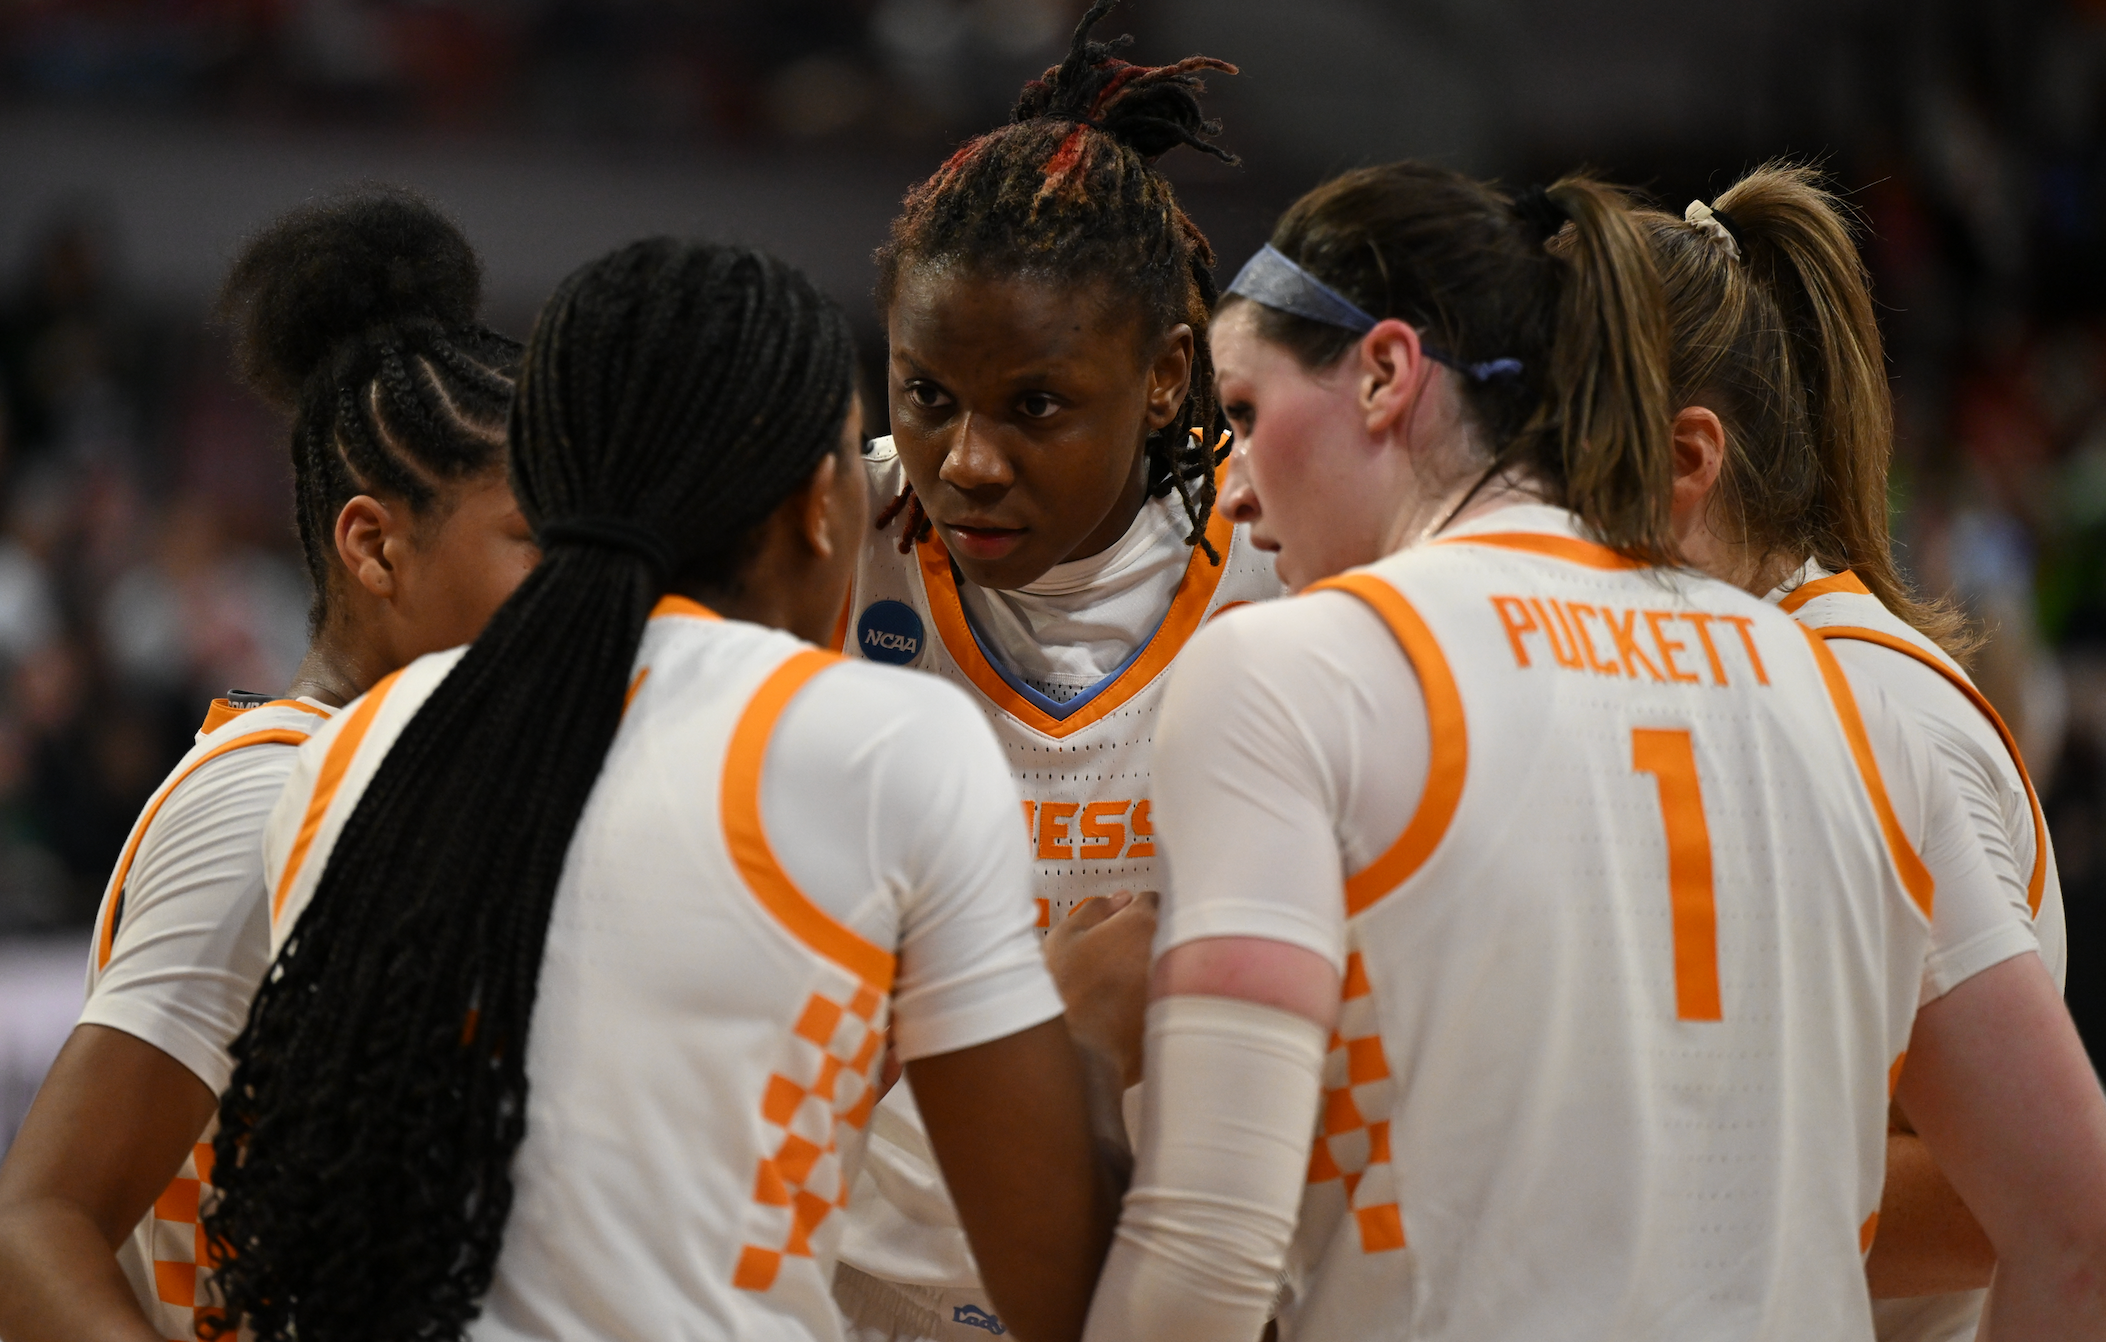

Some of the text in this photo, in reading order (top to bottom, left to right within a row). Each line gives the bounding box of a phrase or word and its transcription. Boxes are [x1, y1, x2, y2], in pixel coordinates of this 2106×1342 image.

[864, 628, 918, 654] NCAA
[1490, 595, 1771, 686] PUCKETT
[1021, 798, 1156, 860] ESS
[1632, 728, 1723, 1022] 1
